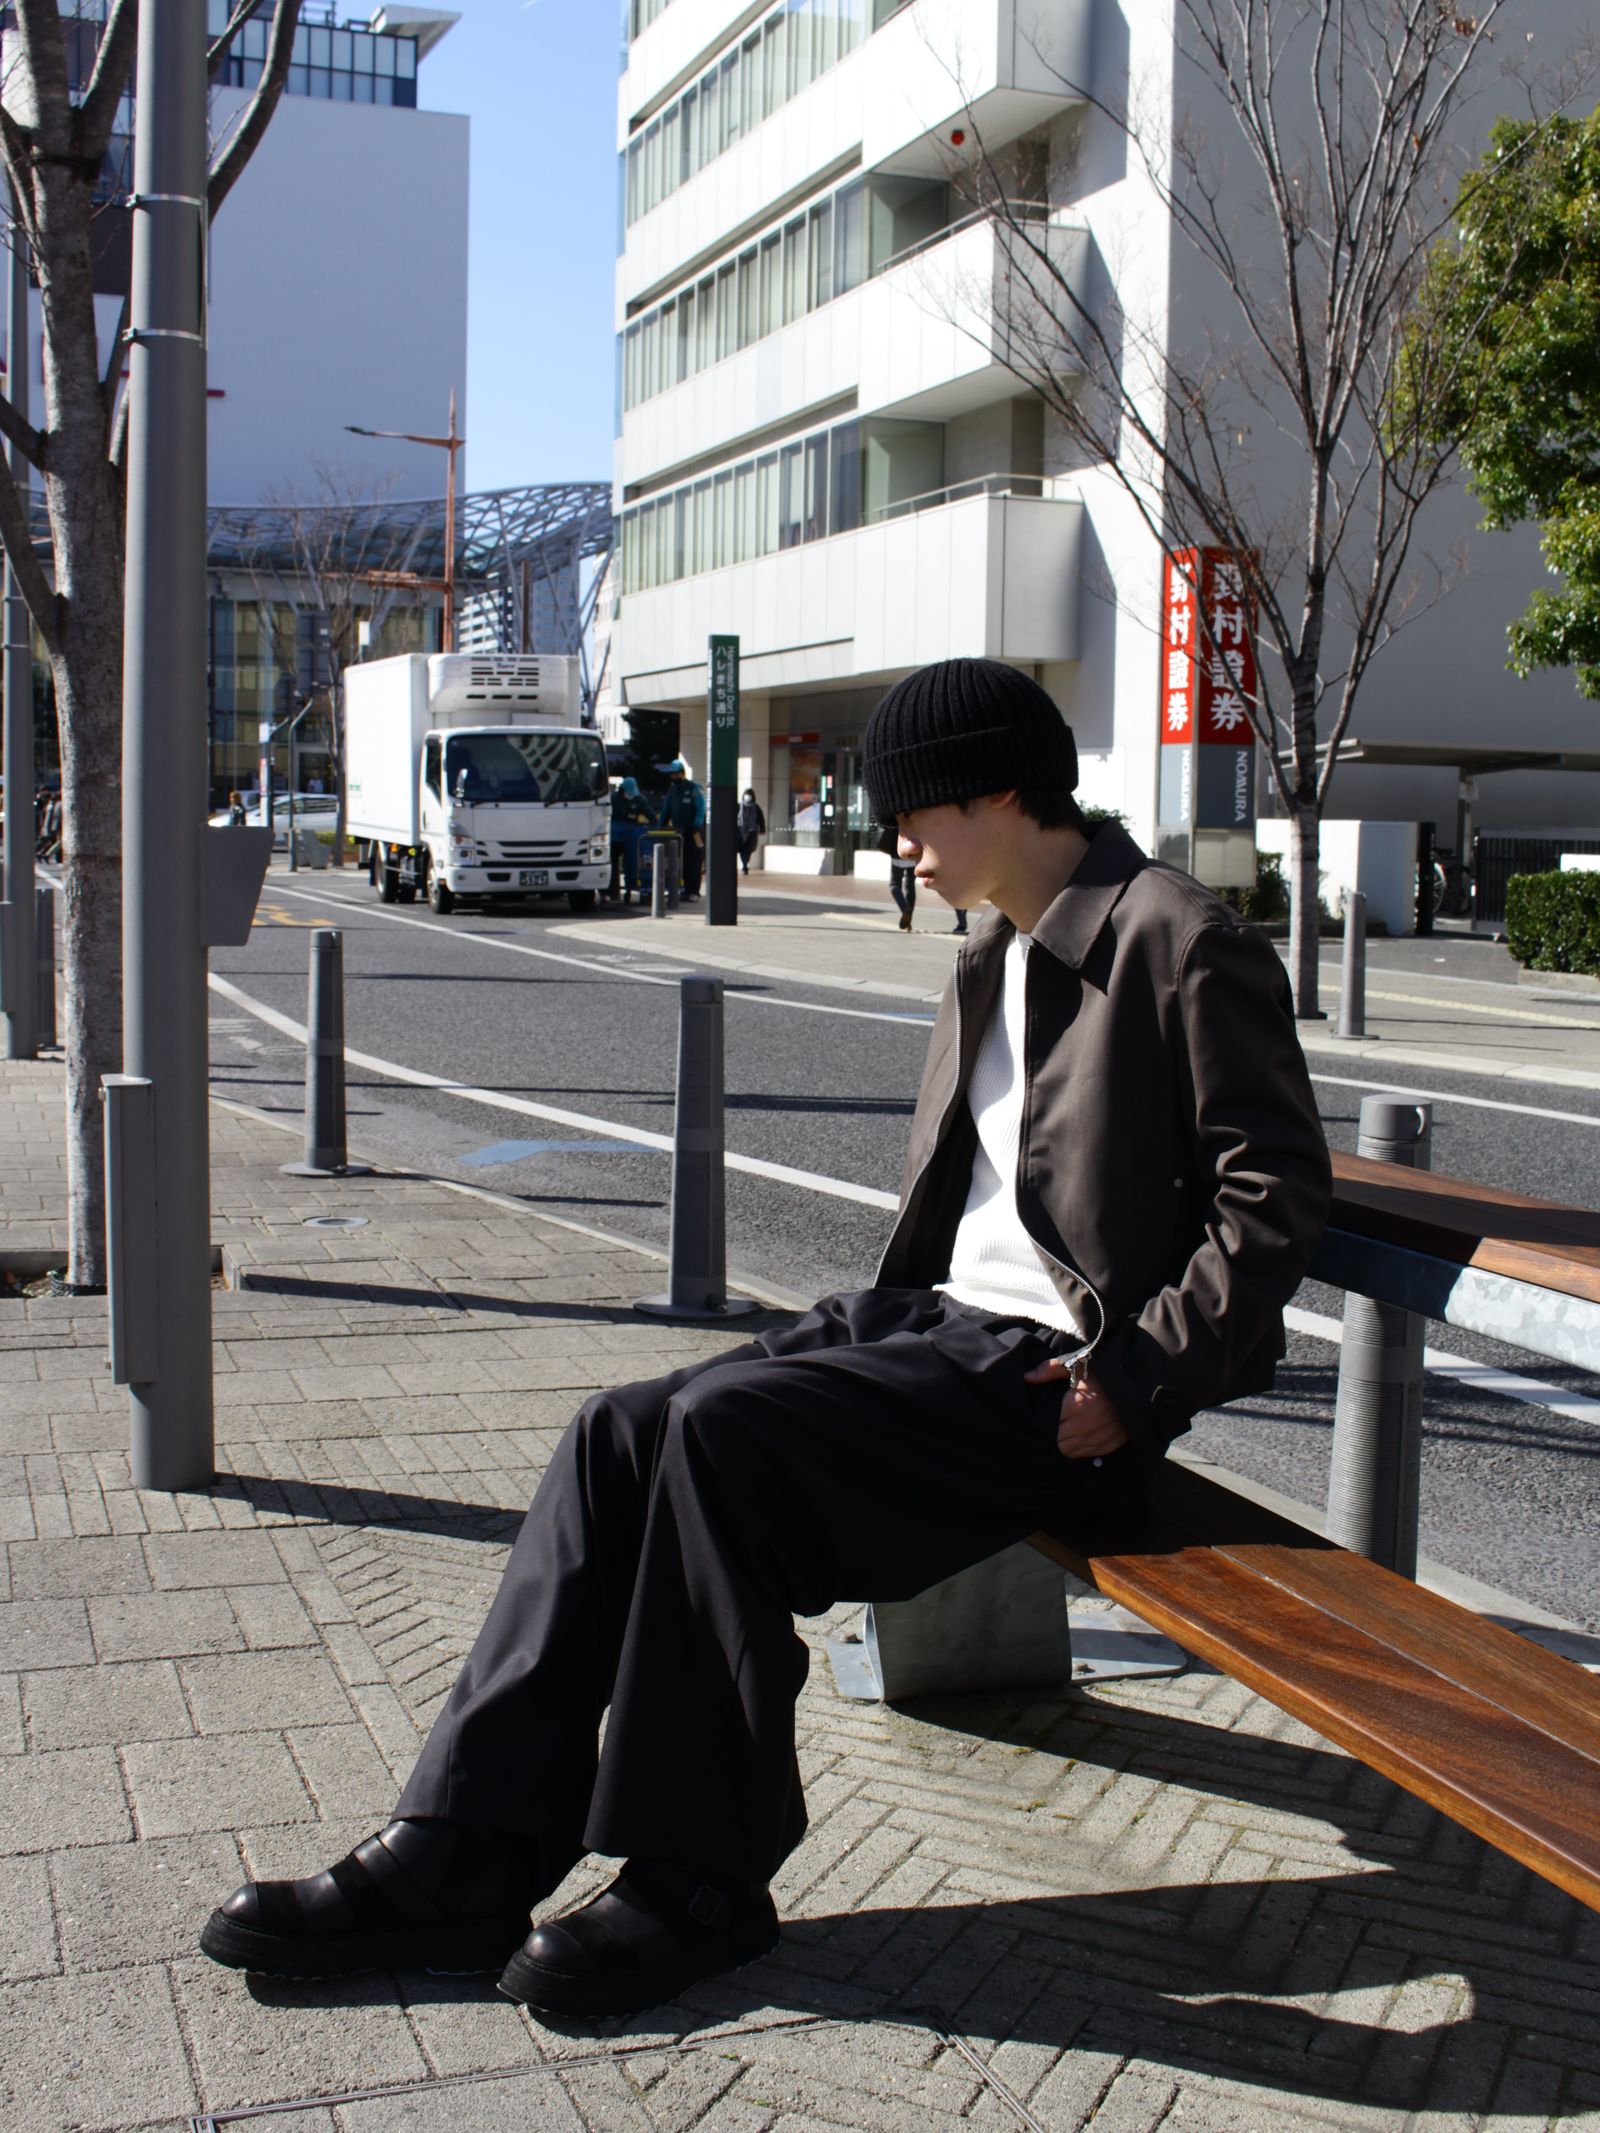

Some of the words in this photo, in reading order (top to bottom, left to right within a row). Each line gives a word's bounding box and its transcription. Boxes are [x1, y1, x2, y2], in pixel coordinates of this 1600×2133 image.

[715, 646, 726, 728] ハレまち通り
[1180, 750, 1190, 821] NOMURA
[1235, 751, 1248, 822] NOMURA
